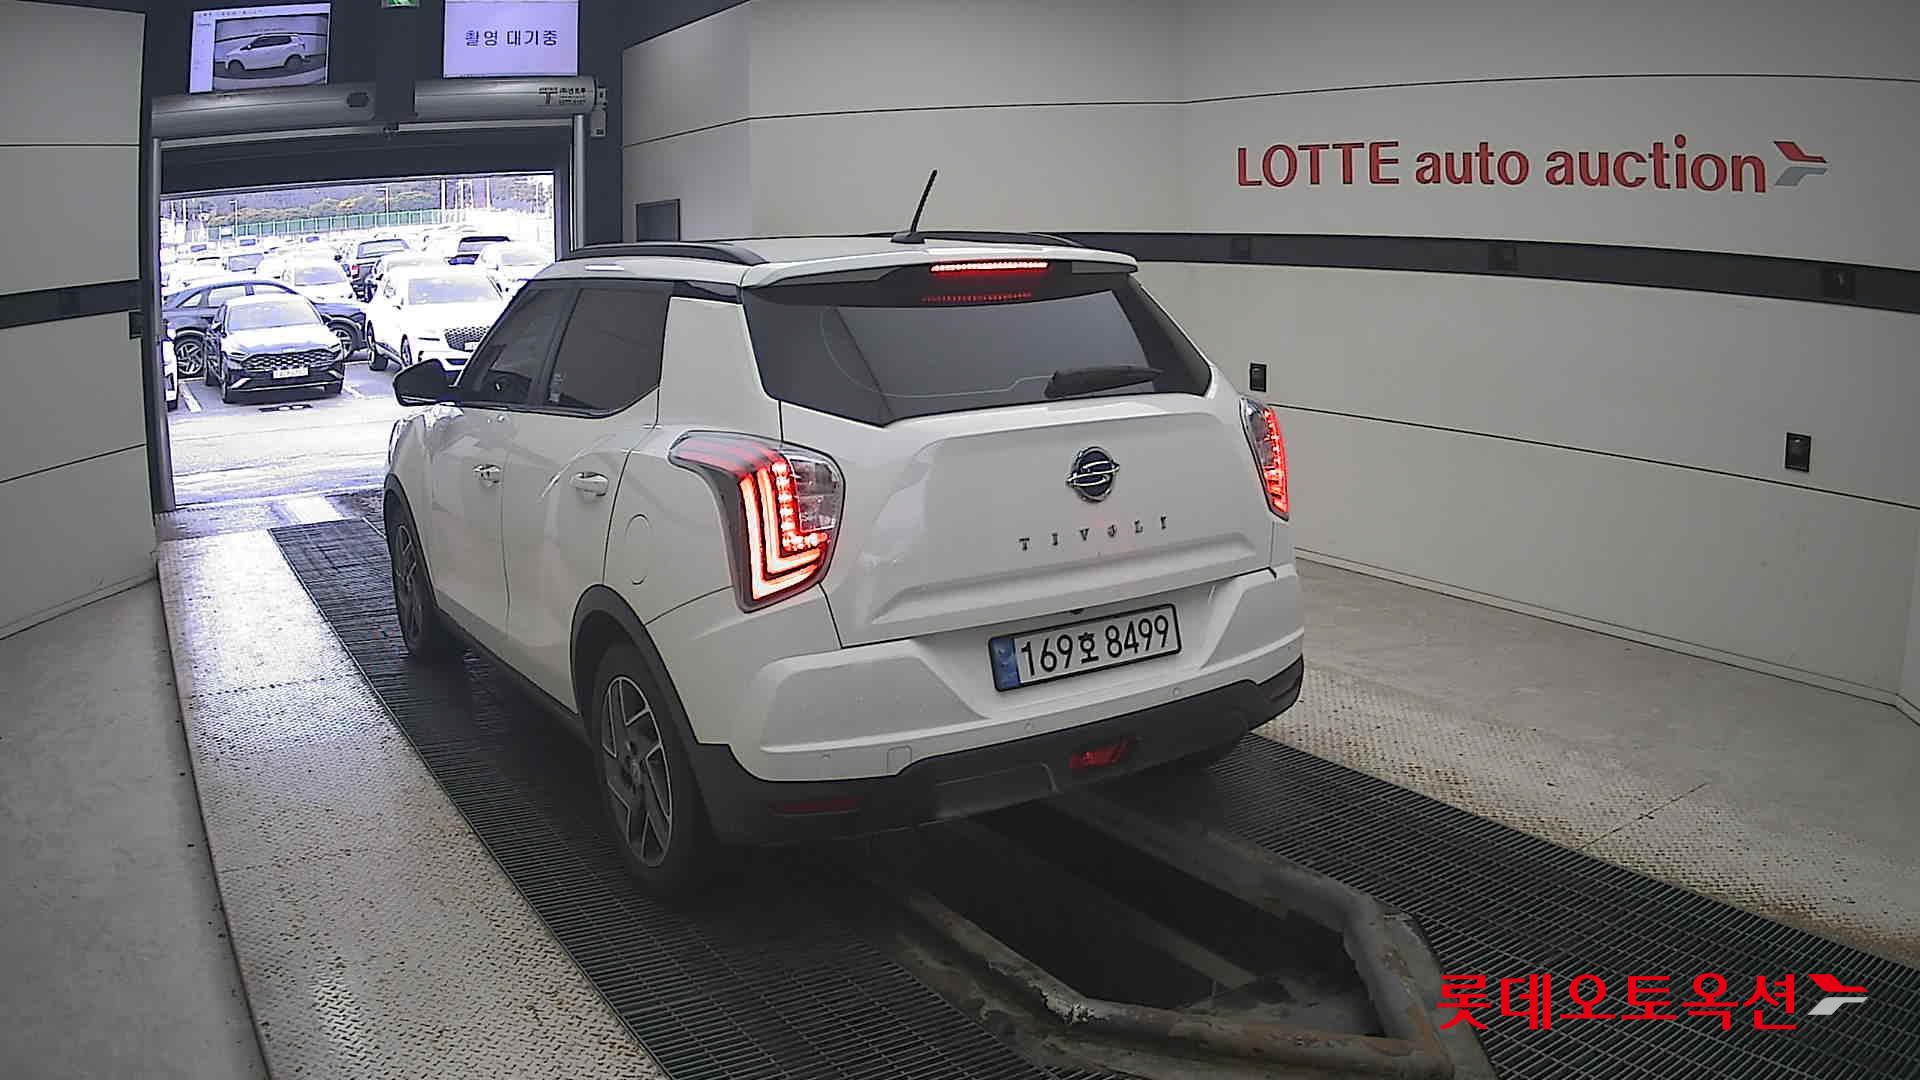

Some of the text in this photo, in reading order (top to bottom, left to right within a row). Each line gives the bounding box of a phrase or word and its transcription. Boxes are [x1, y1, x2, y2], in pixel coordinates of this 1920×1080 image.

[465, 30, 558, 47] 촬영 대기중
[1237, 134, 1767, 193] LOTTE auto auction
[1018, 514, 1168, 551] TIVOLI
[1021, 615, 1169, 676] 169호 8499
